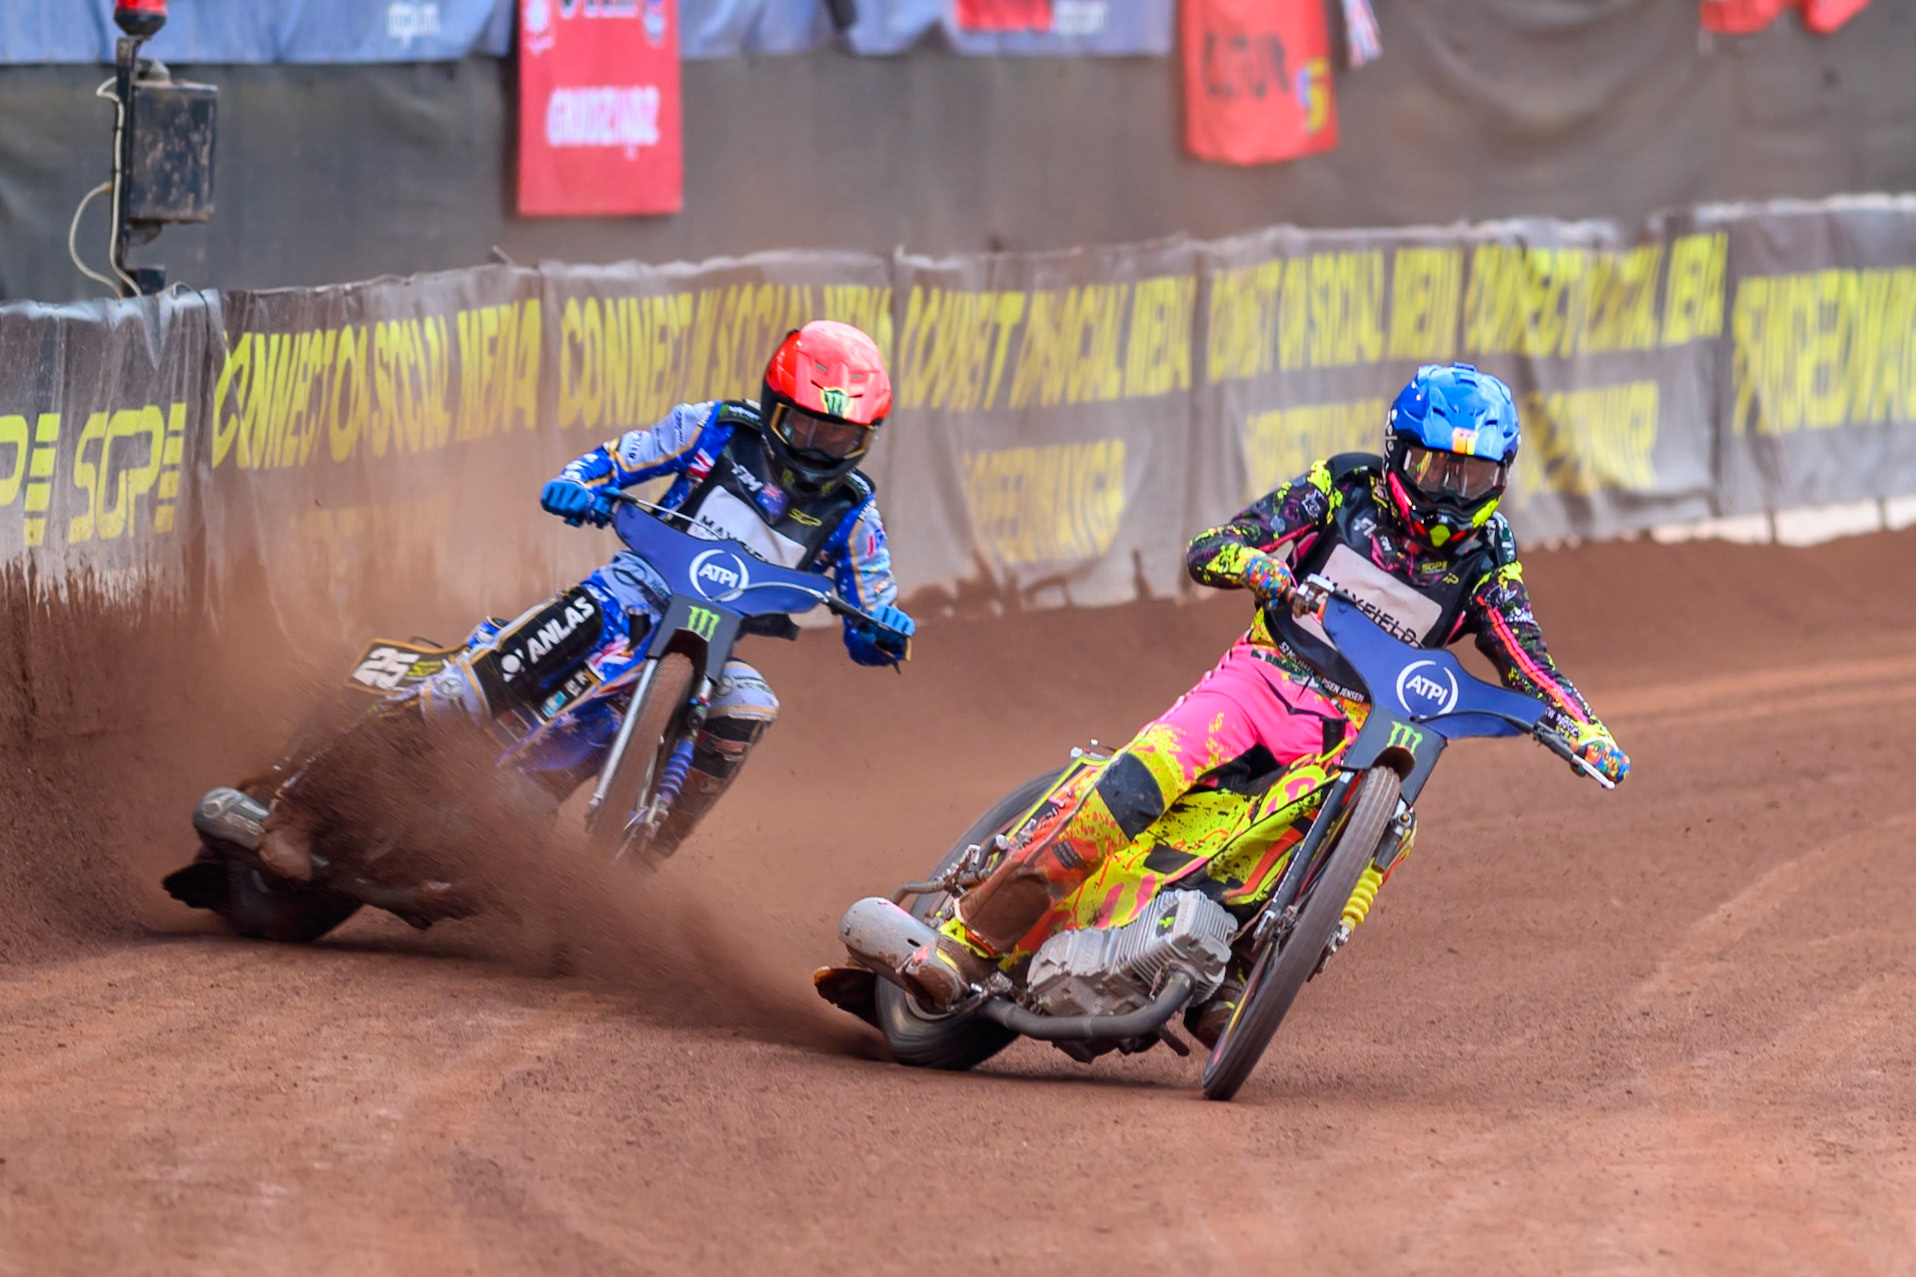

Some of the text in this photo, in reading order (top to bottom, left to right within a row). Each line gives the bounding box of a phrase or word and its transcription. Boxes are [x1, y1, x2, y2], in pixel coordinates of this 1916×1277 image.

[698, 562, 740, 588] ATPI
[527, 595, 595, 664] ANLAS
[352, 646, 420, 692] 25
[1405, 674, 1448, 705] ATPI
